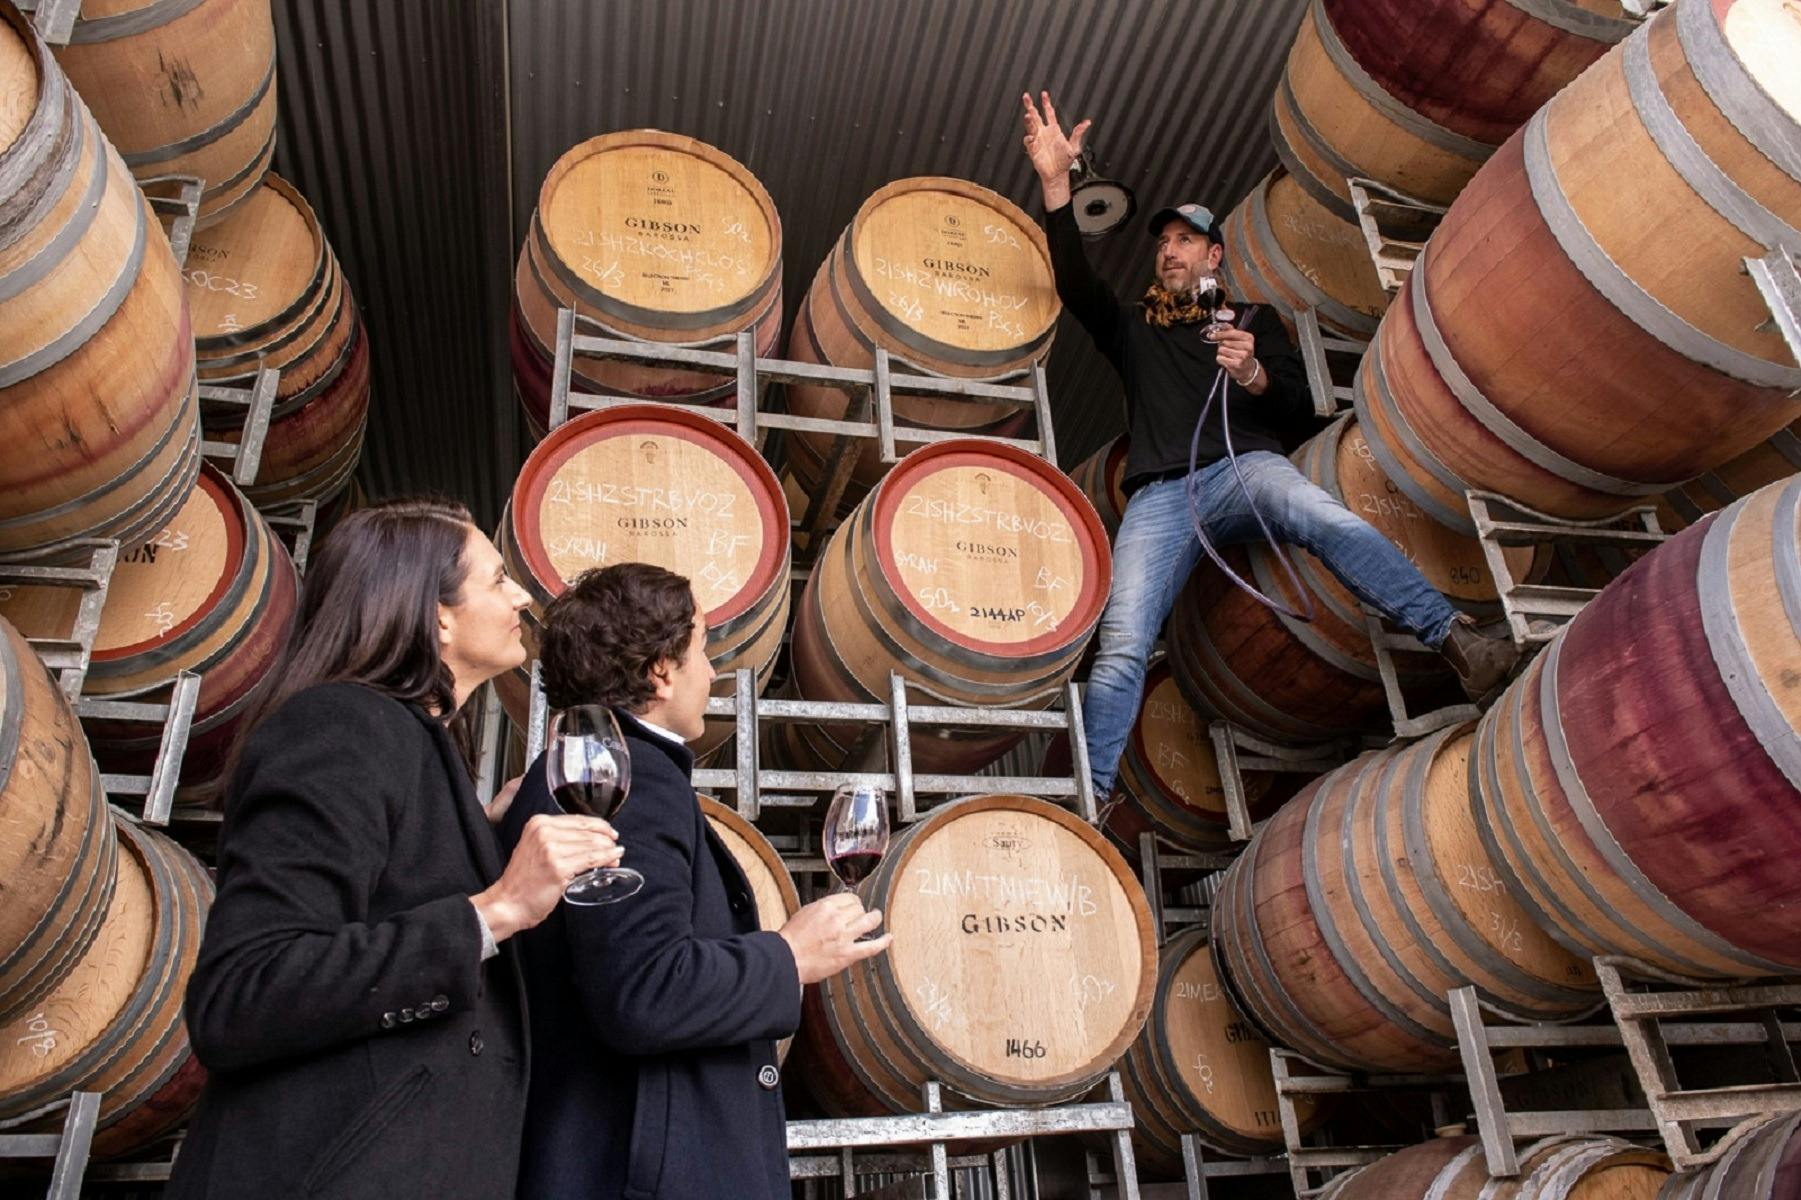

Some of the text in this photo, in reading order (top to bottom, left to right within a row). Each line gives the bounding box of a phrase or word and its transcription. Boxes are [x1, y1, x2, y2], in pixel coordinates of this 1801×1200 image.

[624, 216, 701, 235] GIBSON
[191, 244, 230, 259] SON
[922, 257, 991, 278] GIBSON
[617, 516, 688, 530] GIBSON
[956, 540, 1018, 558] GIBSON
[961, 913, 1067, 934] GIBSON
[1005, 1038, 1047, 1058] 1466
